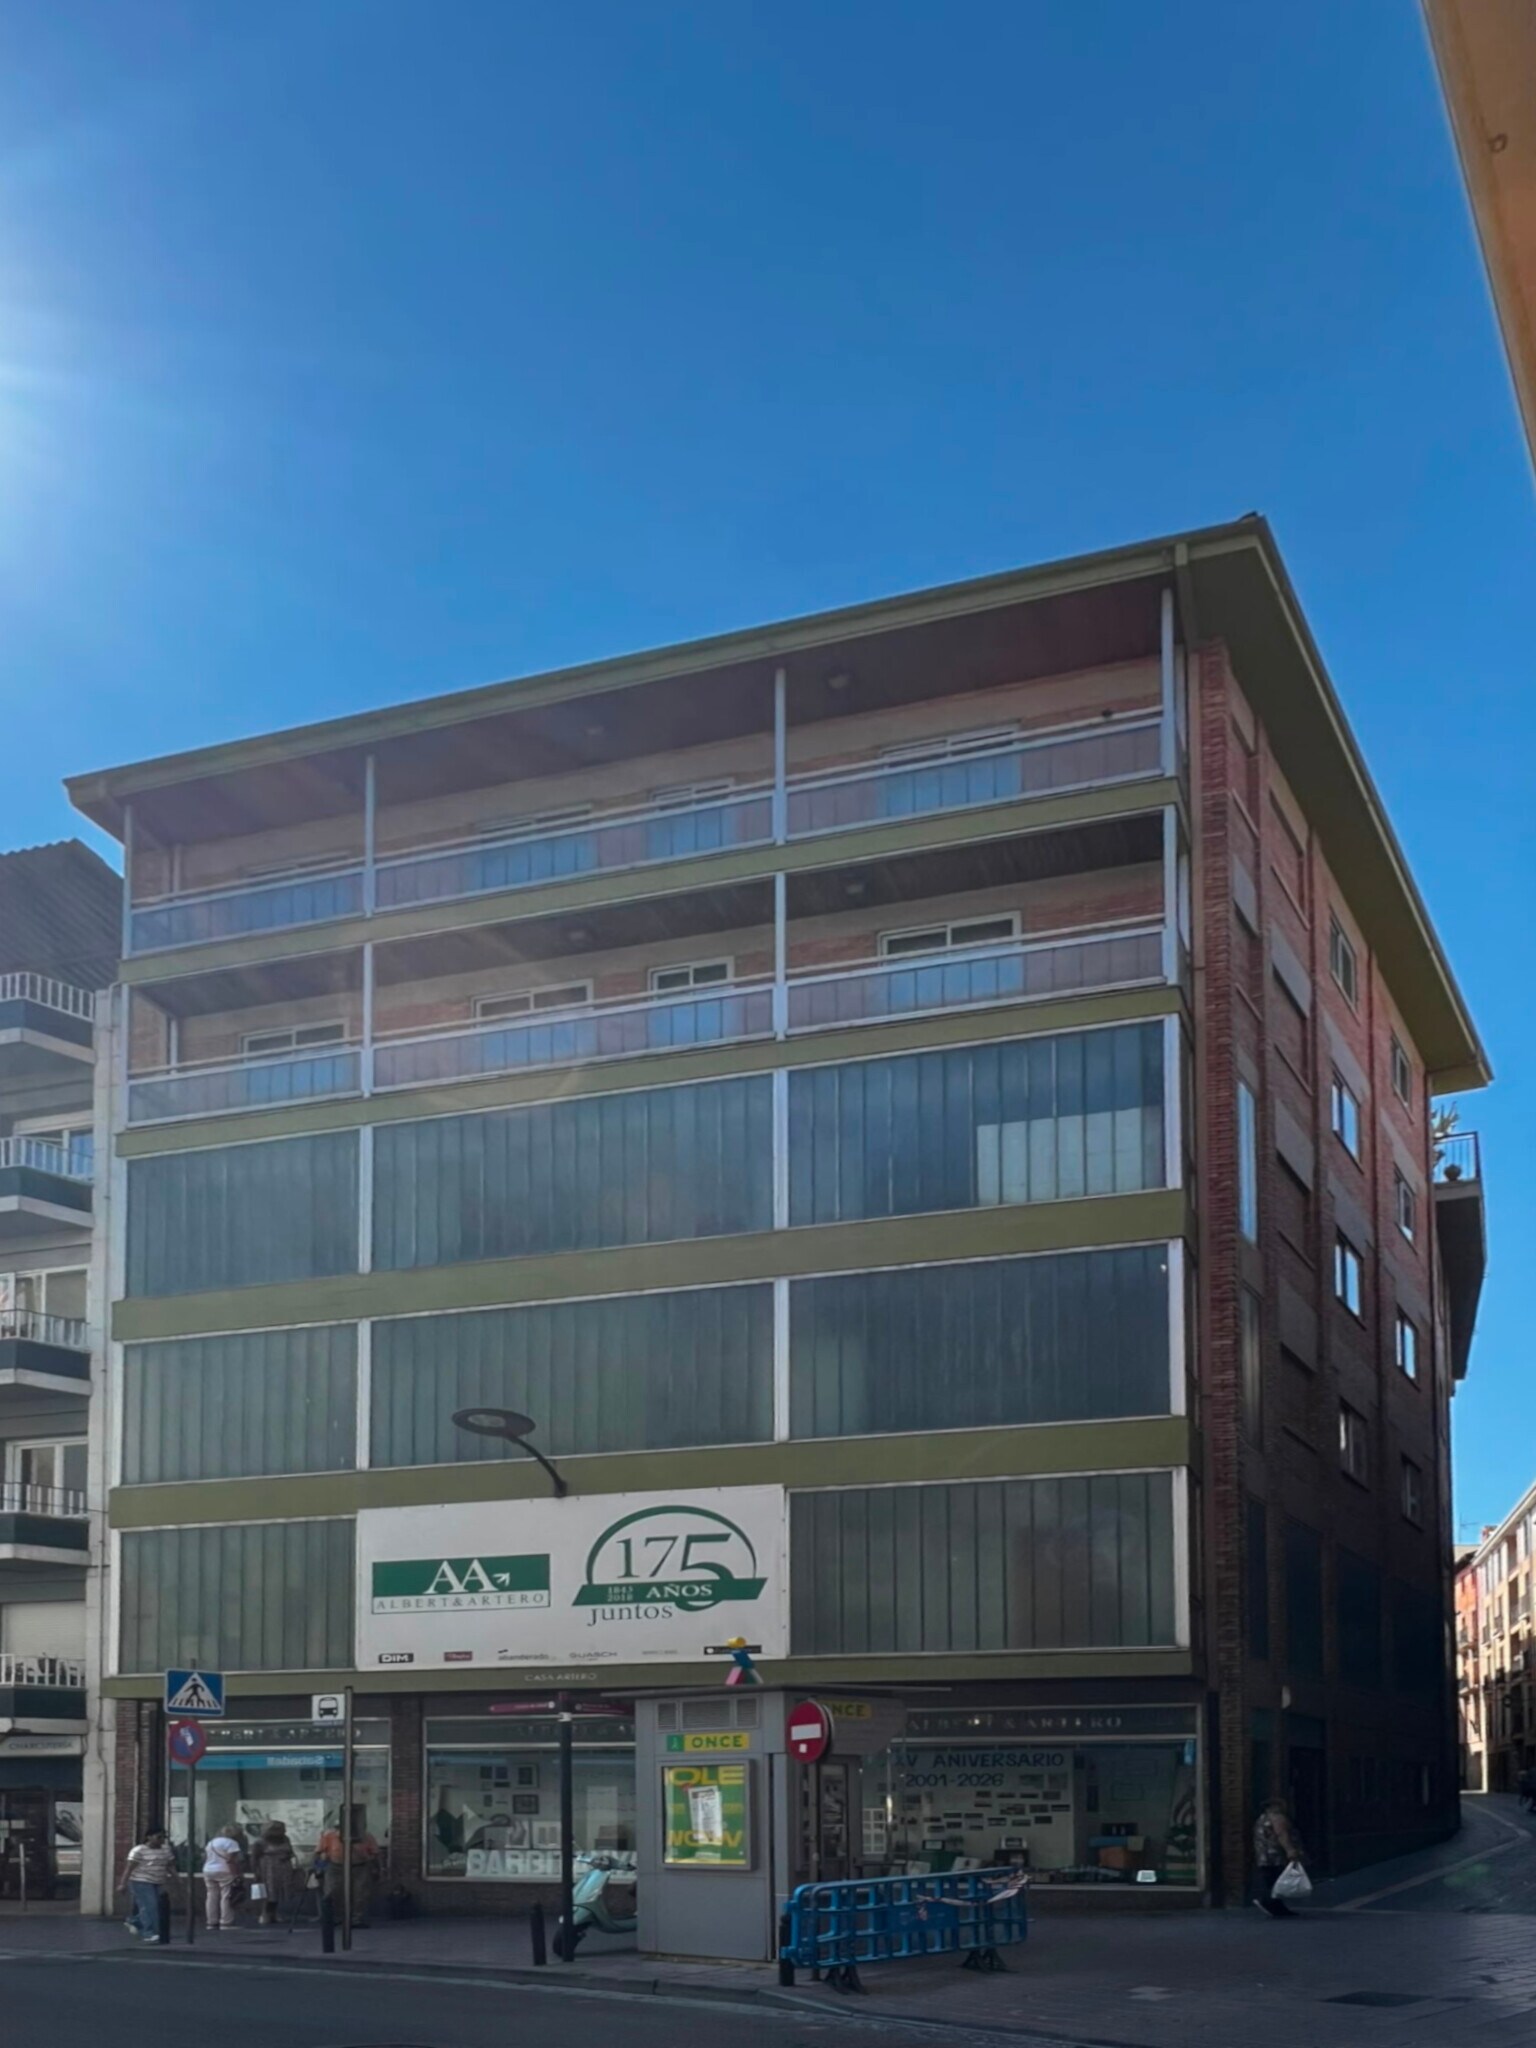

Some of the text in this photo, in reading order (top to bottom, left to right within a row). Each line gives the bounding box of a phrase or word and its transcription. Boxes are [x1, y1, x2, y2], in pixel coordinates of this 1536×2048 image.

[423, 1559, 499, 1594] AA
[616, 1533, 733, 1605] 175
[646, 1583, 712, 1599] AÑOS
[556, 1673, 598, 1681] ARTERO
[828, 1703, 865, 1717] NCE
[692, 1735, 743, 1748] ONCE
[933, 1752, 1064, 1770] ANIVERSARIO
[905, 1773, 1004, 1788] 2001-2026
